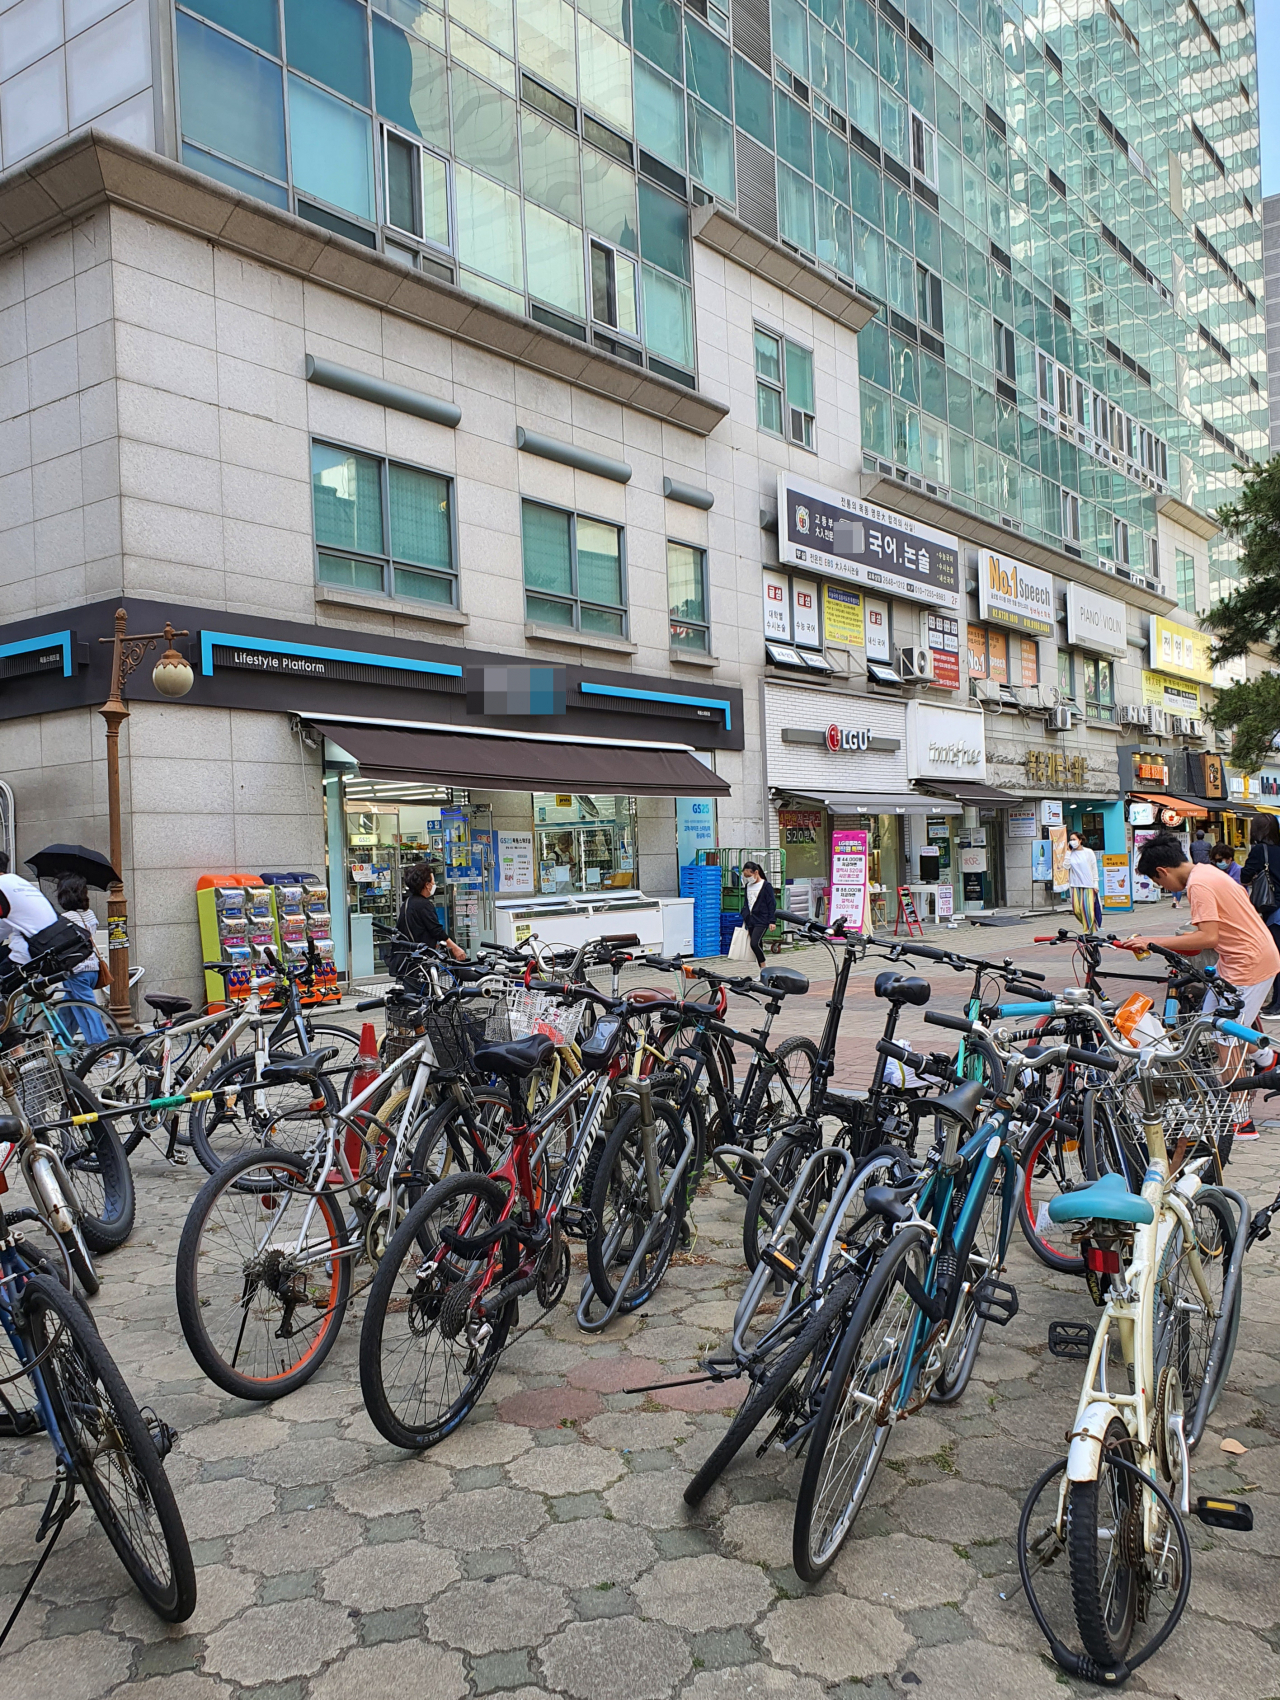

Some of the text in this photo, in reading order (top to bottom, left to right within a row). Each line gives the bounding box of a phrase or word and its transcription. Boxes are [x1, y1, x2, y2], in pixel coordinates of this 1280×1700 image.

[988, 555, 1051, 607] No.1 Speech
[234, 652, 325, 673] Lifestyle Platform
[967, 648, 986, 673] No.1
[928, 740, 981, 768] innisfree
[692, 803, 710, 814] GS25
[562, 1085, 612, 1207] SCHWINN
